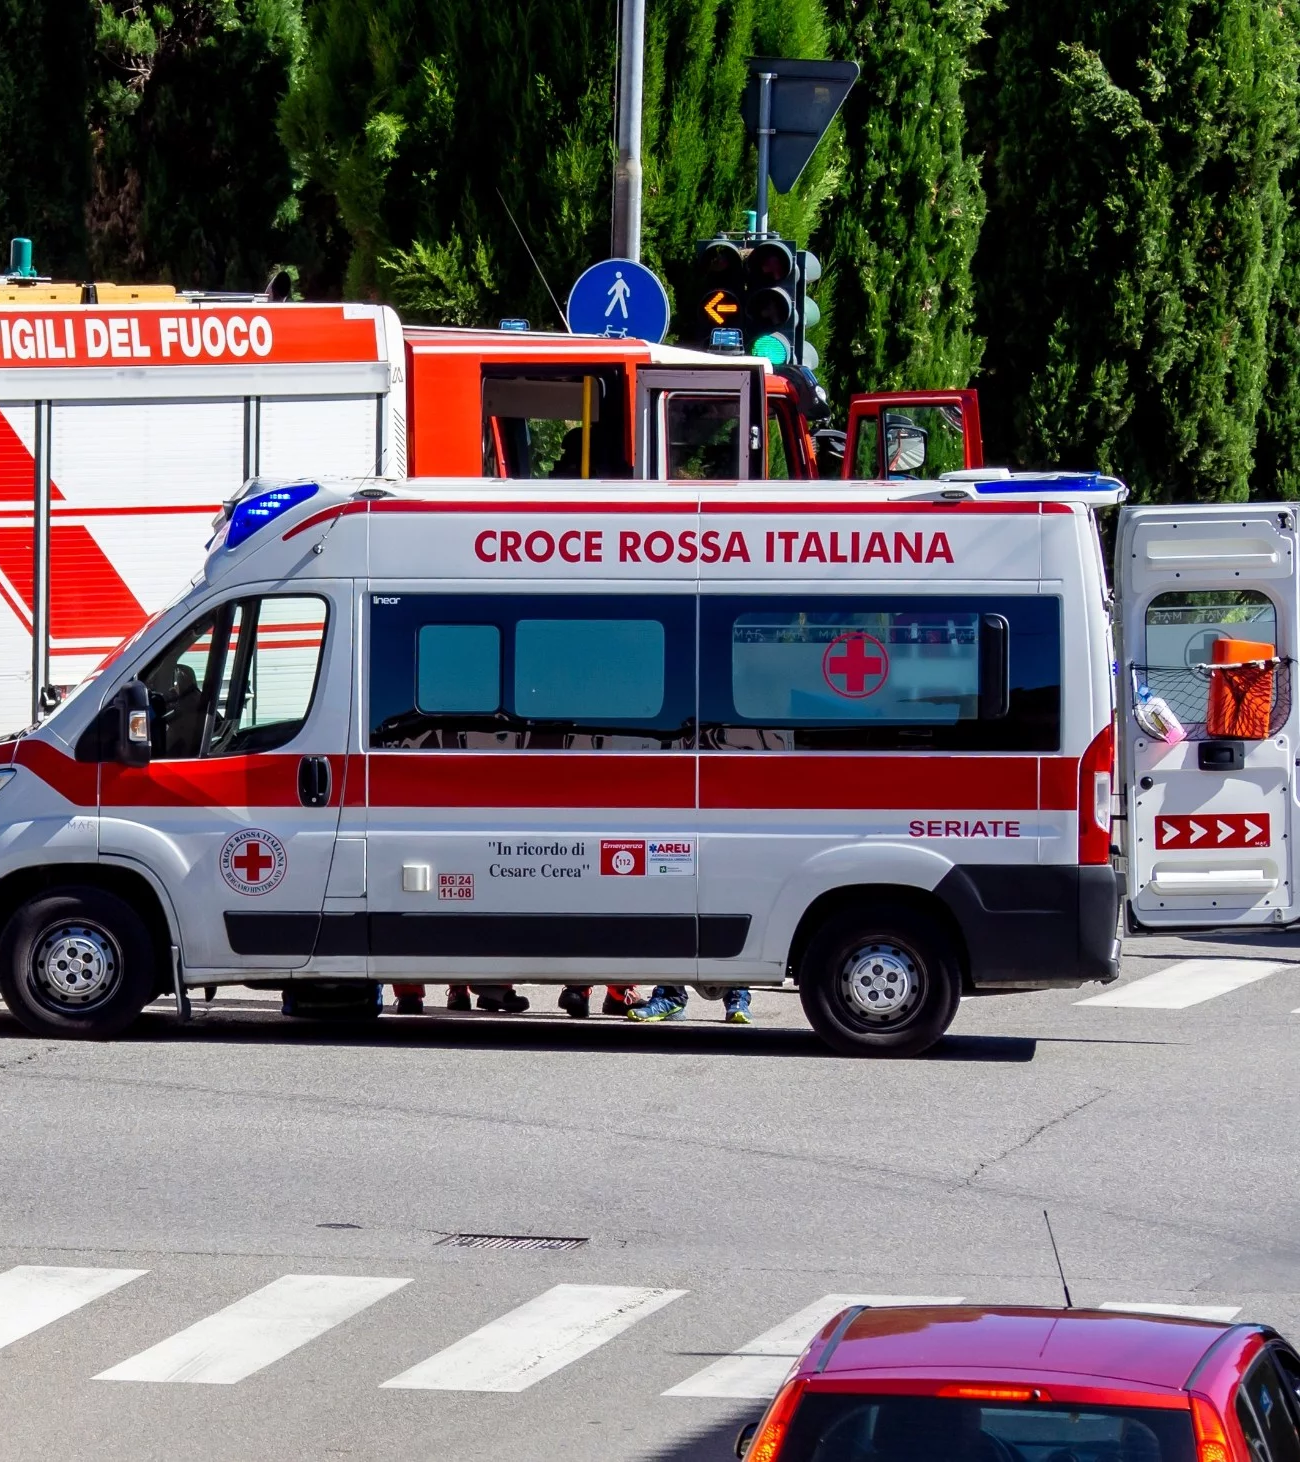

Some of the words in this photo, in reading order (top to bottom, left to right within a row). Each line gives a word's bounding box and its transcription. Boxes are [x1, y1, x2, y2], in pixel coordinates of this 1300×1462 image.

[84, 318, 151, 358] DEL
[159, 315, 273, 357] FUOCO
[474, 530, 603, 563] CROCE
[619, 530, 750, 563] ROSSA
[765, 530, 955, 564] ITALIANA
[373, 595, 401, 605] linear
[908, 820, 1021, 838] SERIATE
[222, 841, 236, 869] CROCE
[234, 832, 260, 843] ROSSA
[262, 834, 284, 867] ITALIANA
[517, 841, 567, 856] ricordo
[571, 841, 585, 856] di
[602, 842, 643, 850] Emergenza
[656, 843, 691, 853] AREU
[619, 858, 631, 866] 112
[489, 863, 536, 878] Cesare
[541, 863, 590, 878] Cerea"
[225, 871, 249, 893] BERGAMO
[250, 870, 282, 894] HINTERLAND
[440, 876, 455, 885] BG
[458, 876, 471, 885] 24
[440, 888, 472, 898] 11-08
